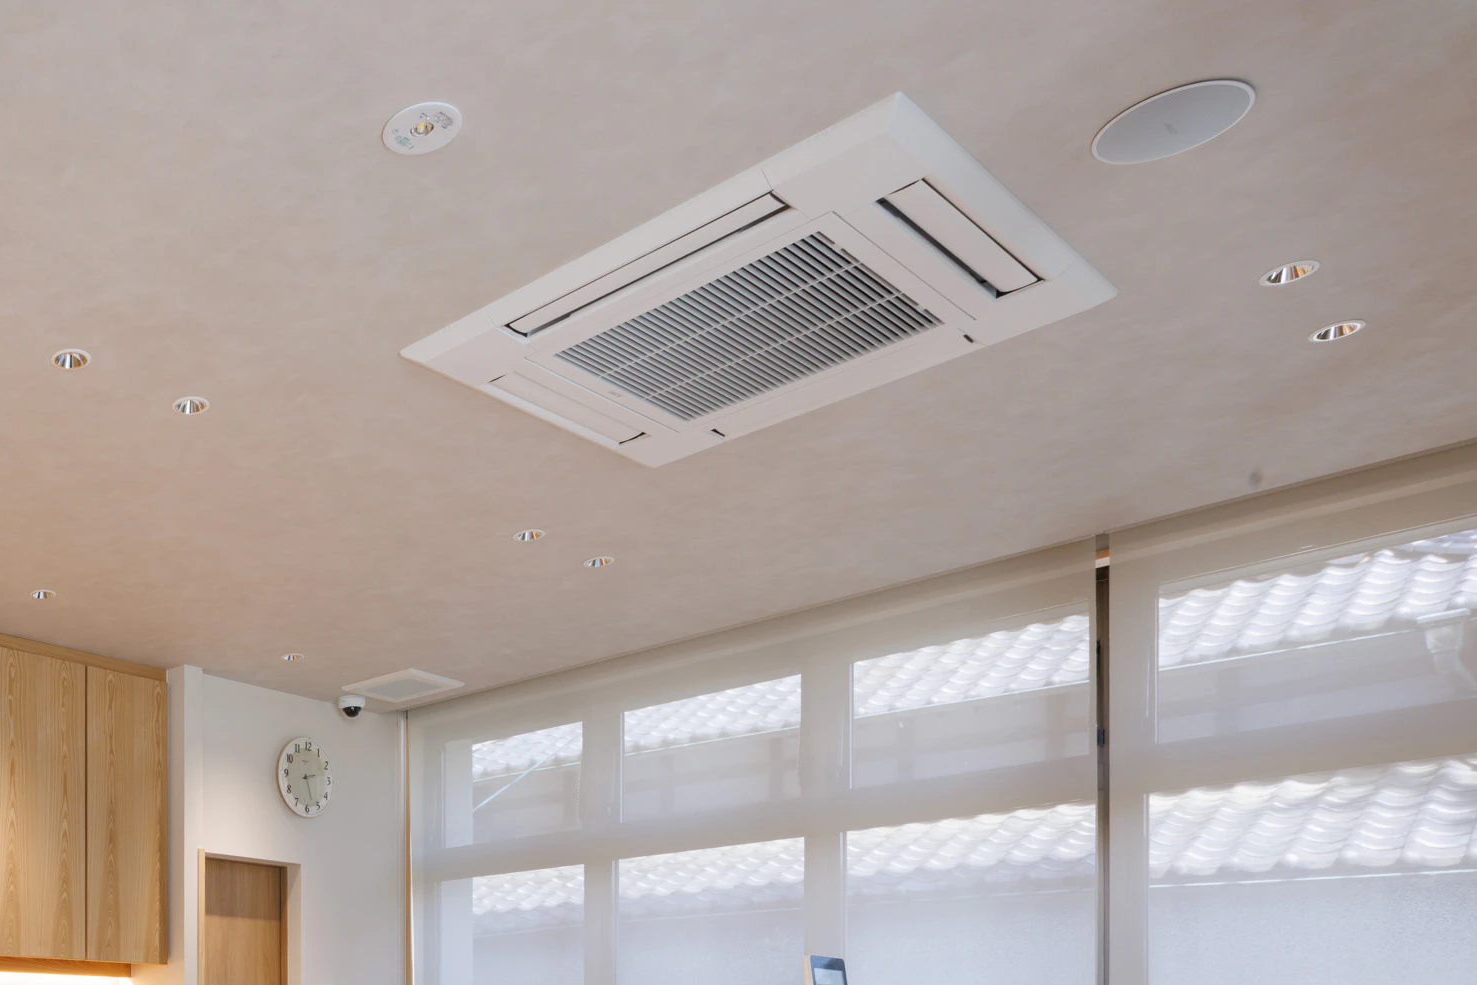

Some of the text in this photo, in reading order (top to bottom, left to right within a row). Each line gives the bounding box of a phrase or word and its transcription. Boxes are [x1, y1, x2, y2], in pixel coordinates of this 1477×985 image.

[295, 744, 300, 753] 11
[305, 741, 312, 751] 12
[287, 754, 293, 763] 10
[324, 761, 329, 770] 2
[284, 769, 289, 777] 9
[327, 777, 331, 786] 3
[287, 785, 292, 794] 8
[323, 792, 328, 800] 4
[295, 797, 299, 807] 7
[316, 801, 321, 810] 5
[305, 804, 310, 813] 6
